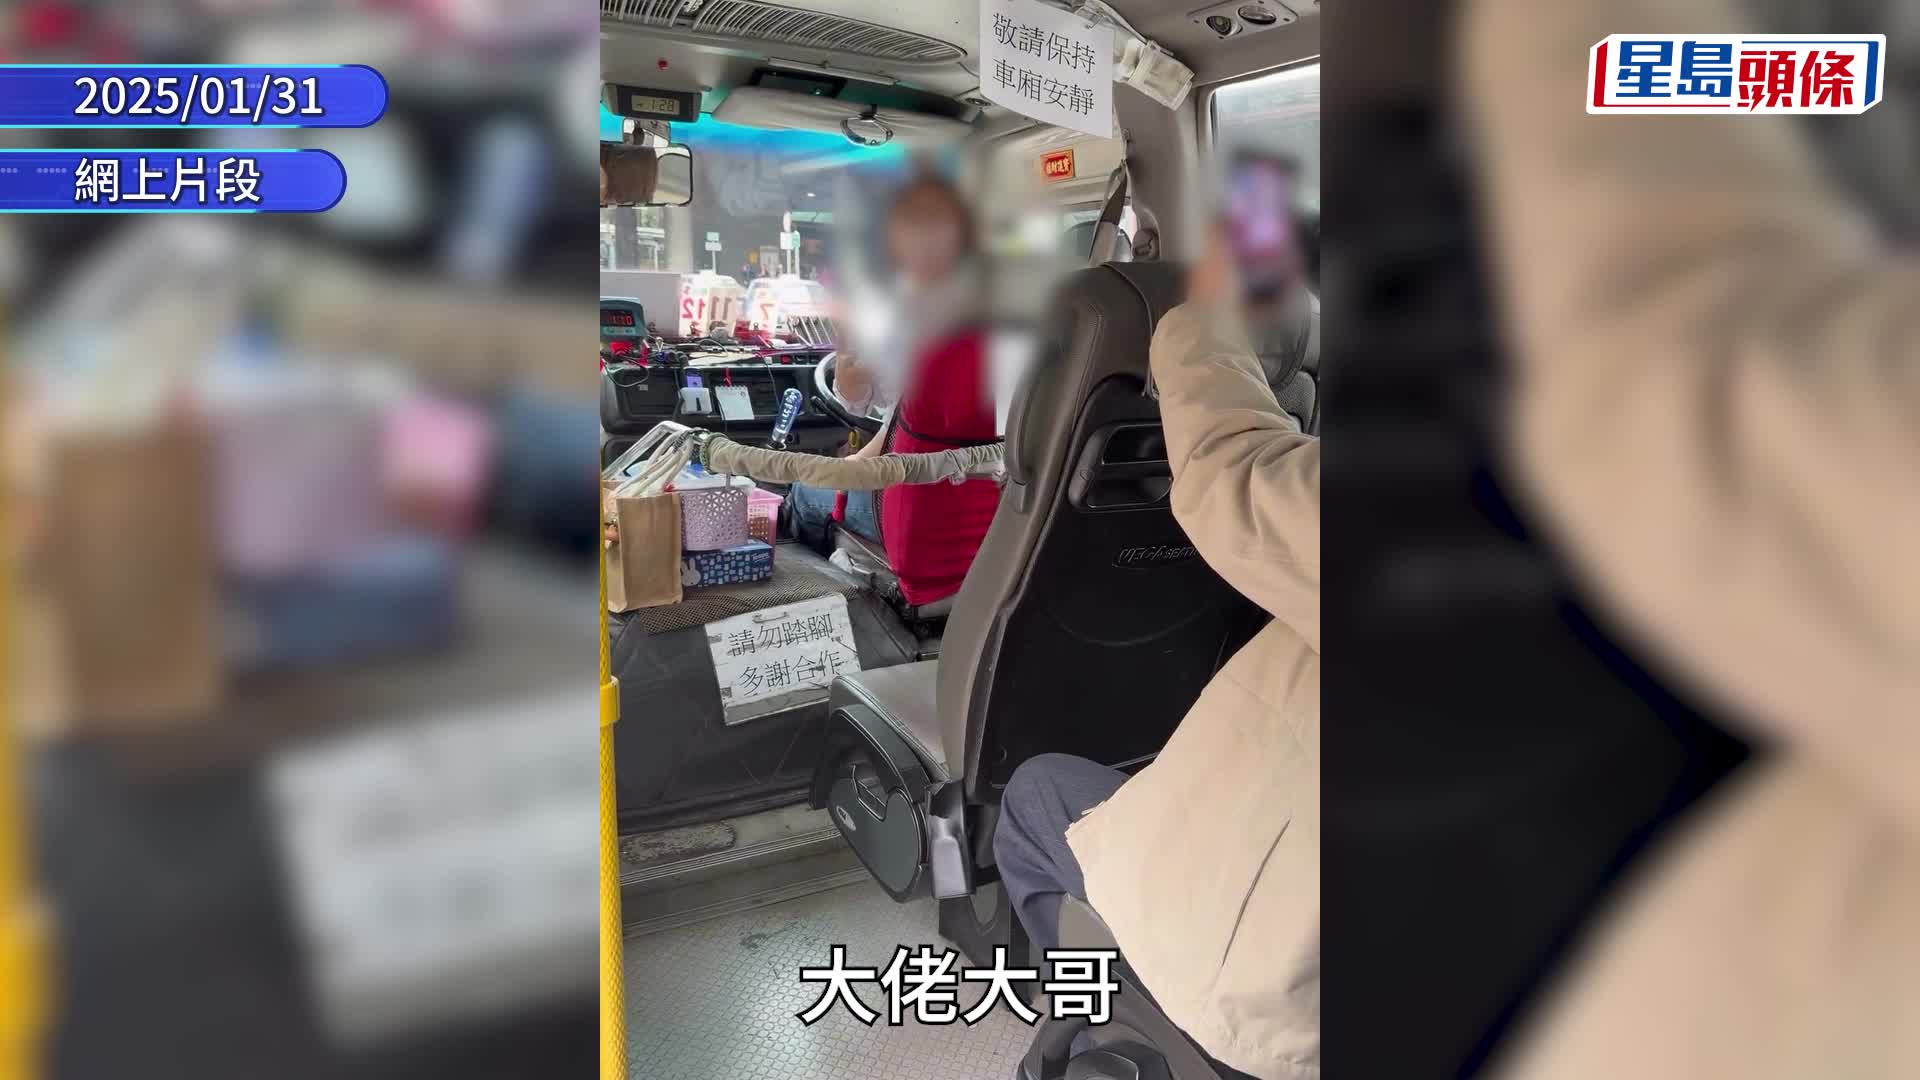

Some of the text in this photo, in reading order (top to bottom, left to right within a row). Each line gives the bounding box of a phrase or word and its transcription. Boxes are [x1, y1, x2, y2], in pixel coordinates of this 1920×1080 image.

[993, 13, 1096, 74] 敬請保持
[992, 58, 1095, 115] 車廂安靜
[727, 613, 834, 657] 請勿踏腳
[737, 650, 844, 696] 多謝合作
